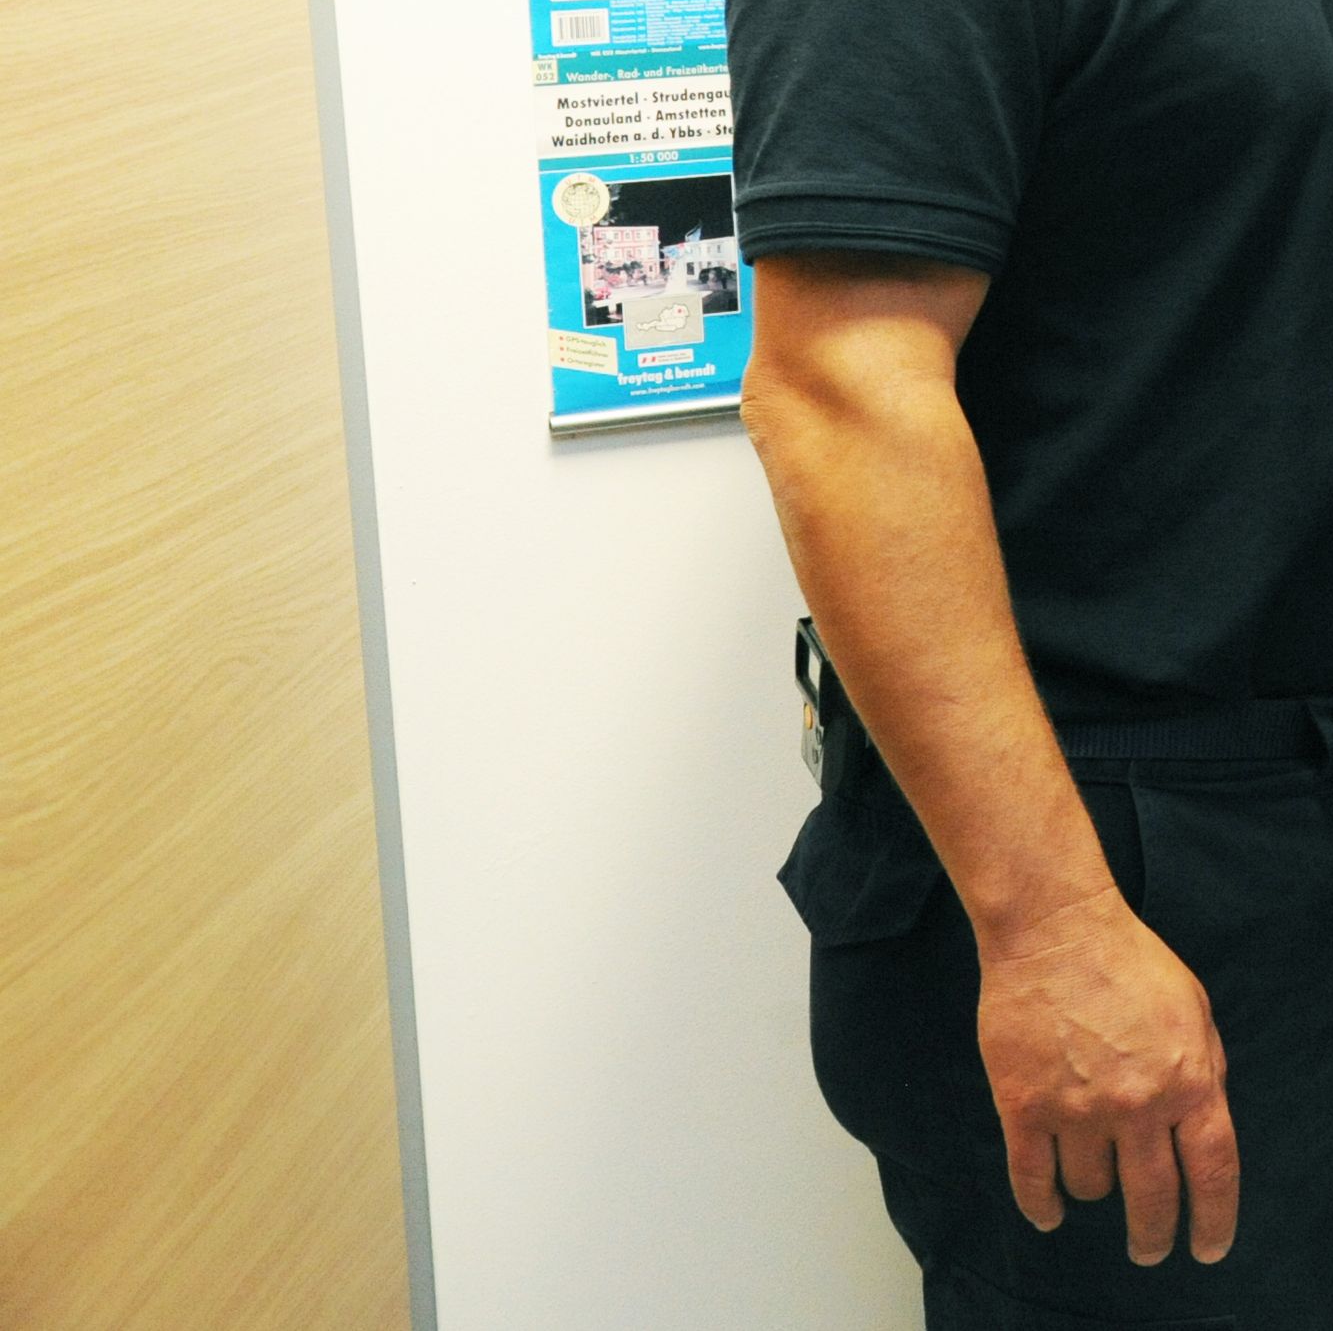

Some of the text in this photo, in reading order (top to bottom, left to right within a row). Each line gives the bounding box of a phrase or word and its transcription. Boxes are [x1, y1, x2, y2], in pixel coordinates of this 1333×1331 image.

[537, 62, 553, 71] WK
[617, 68, 641, 79] Rad-
[643, 66, 663, 78] und
[536, 72, 555, 82] 052
[557, 88, 730, 110] Mostviertel Strudengau
[565, 107, 726, 128] Donauland Amstetten
[552, 124, 734, 148] Waidhofen a. d. Ybbs Ste
[628, 150, 679, 164] 1:50 000
[617, 363, 715, 385] freytag & berndt
